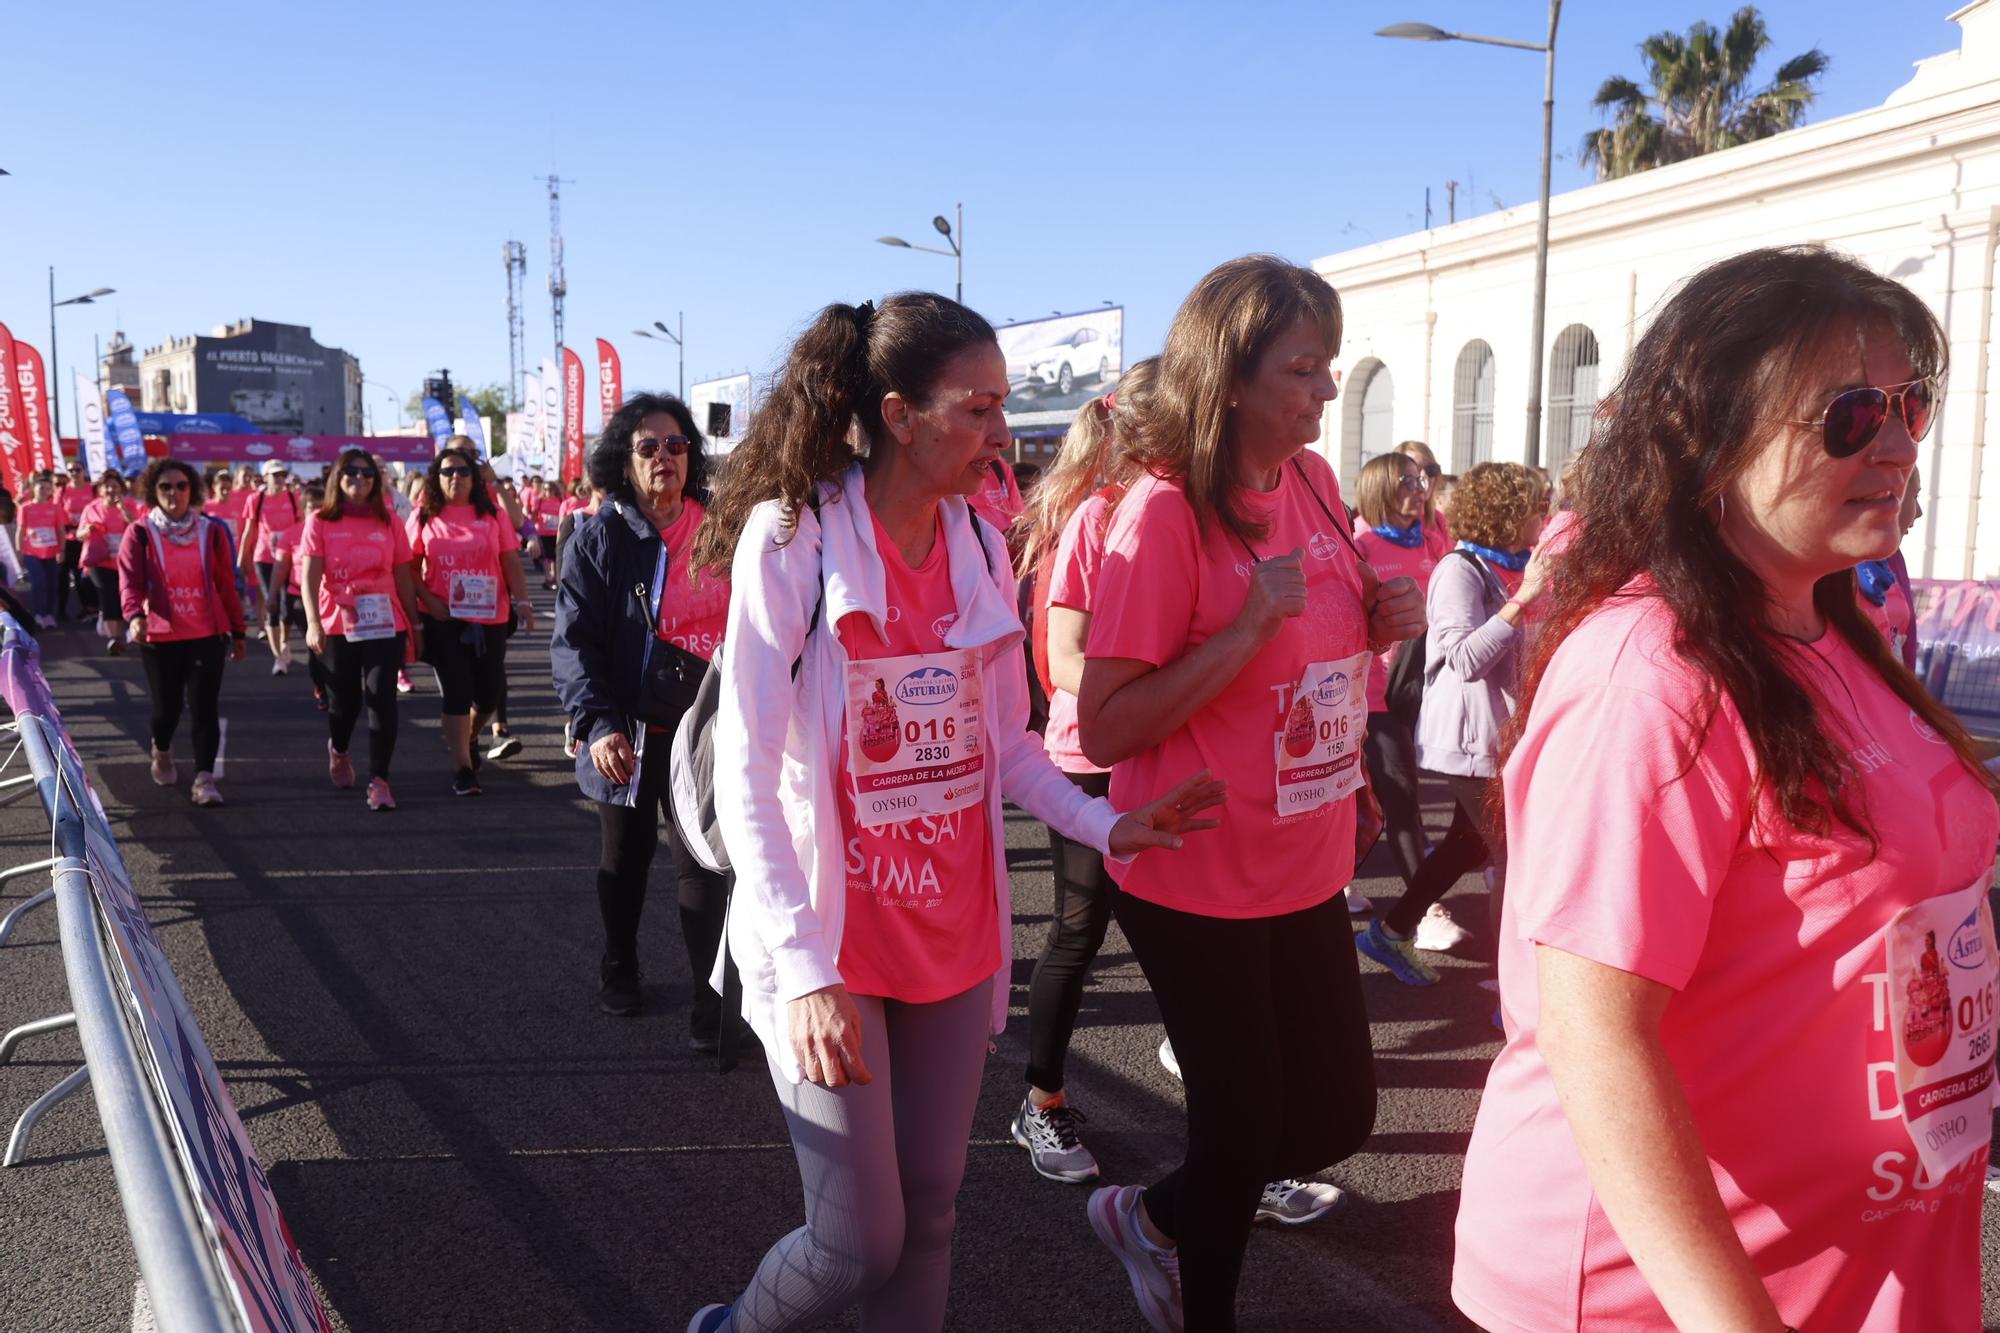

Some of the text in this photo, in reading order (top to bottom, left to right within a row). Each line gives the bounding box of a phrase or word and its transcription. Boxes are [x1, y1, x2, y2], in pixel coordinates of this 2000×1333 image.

[901, 683, 957, 698] ASTURIANA
[905, 717, 956, 743] 016
[1320, 715, 1348, 740] 016
[915, 746, 950, 761] 2830
[1327, 741, 1344, 757] 1150
[872, 773, 915, 788] CARRERA
[916, 769, 930, 781] DE
[931, 767, 944, 779] LA
[1291, 767, 1325, 780] CARRERA
[872, 795, 918, 814] OYSHO
[1290, 787, 1325, 803] OYSHO
[1958, 981, 1992, 1031] 016
[1919, 1080, 1966, 1108] CARRERA
[1925, 1115, 1967, 1151] OYSHO
